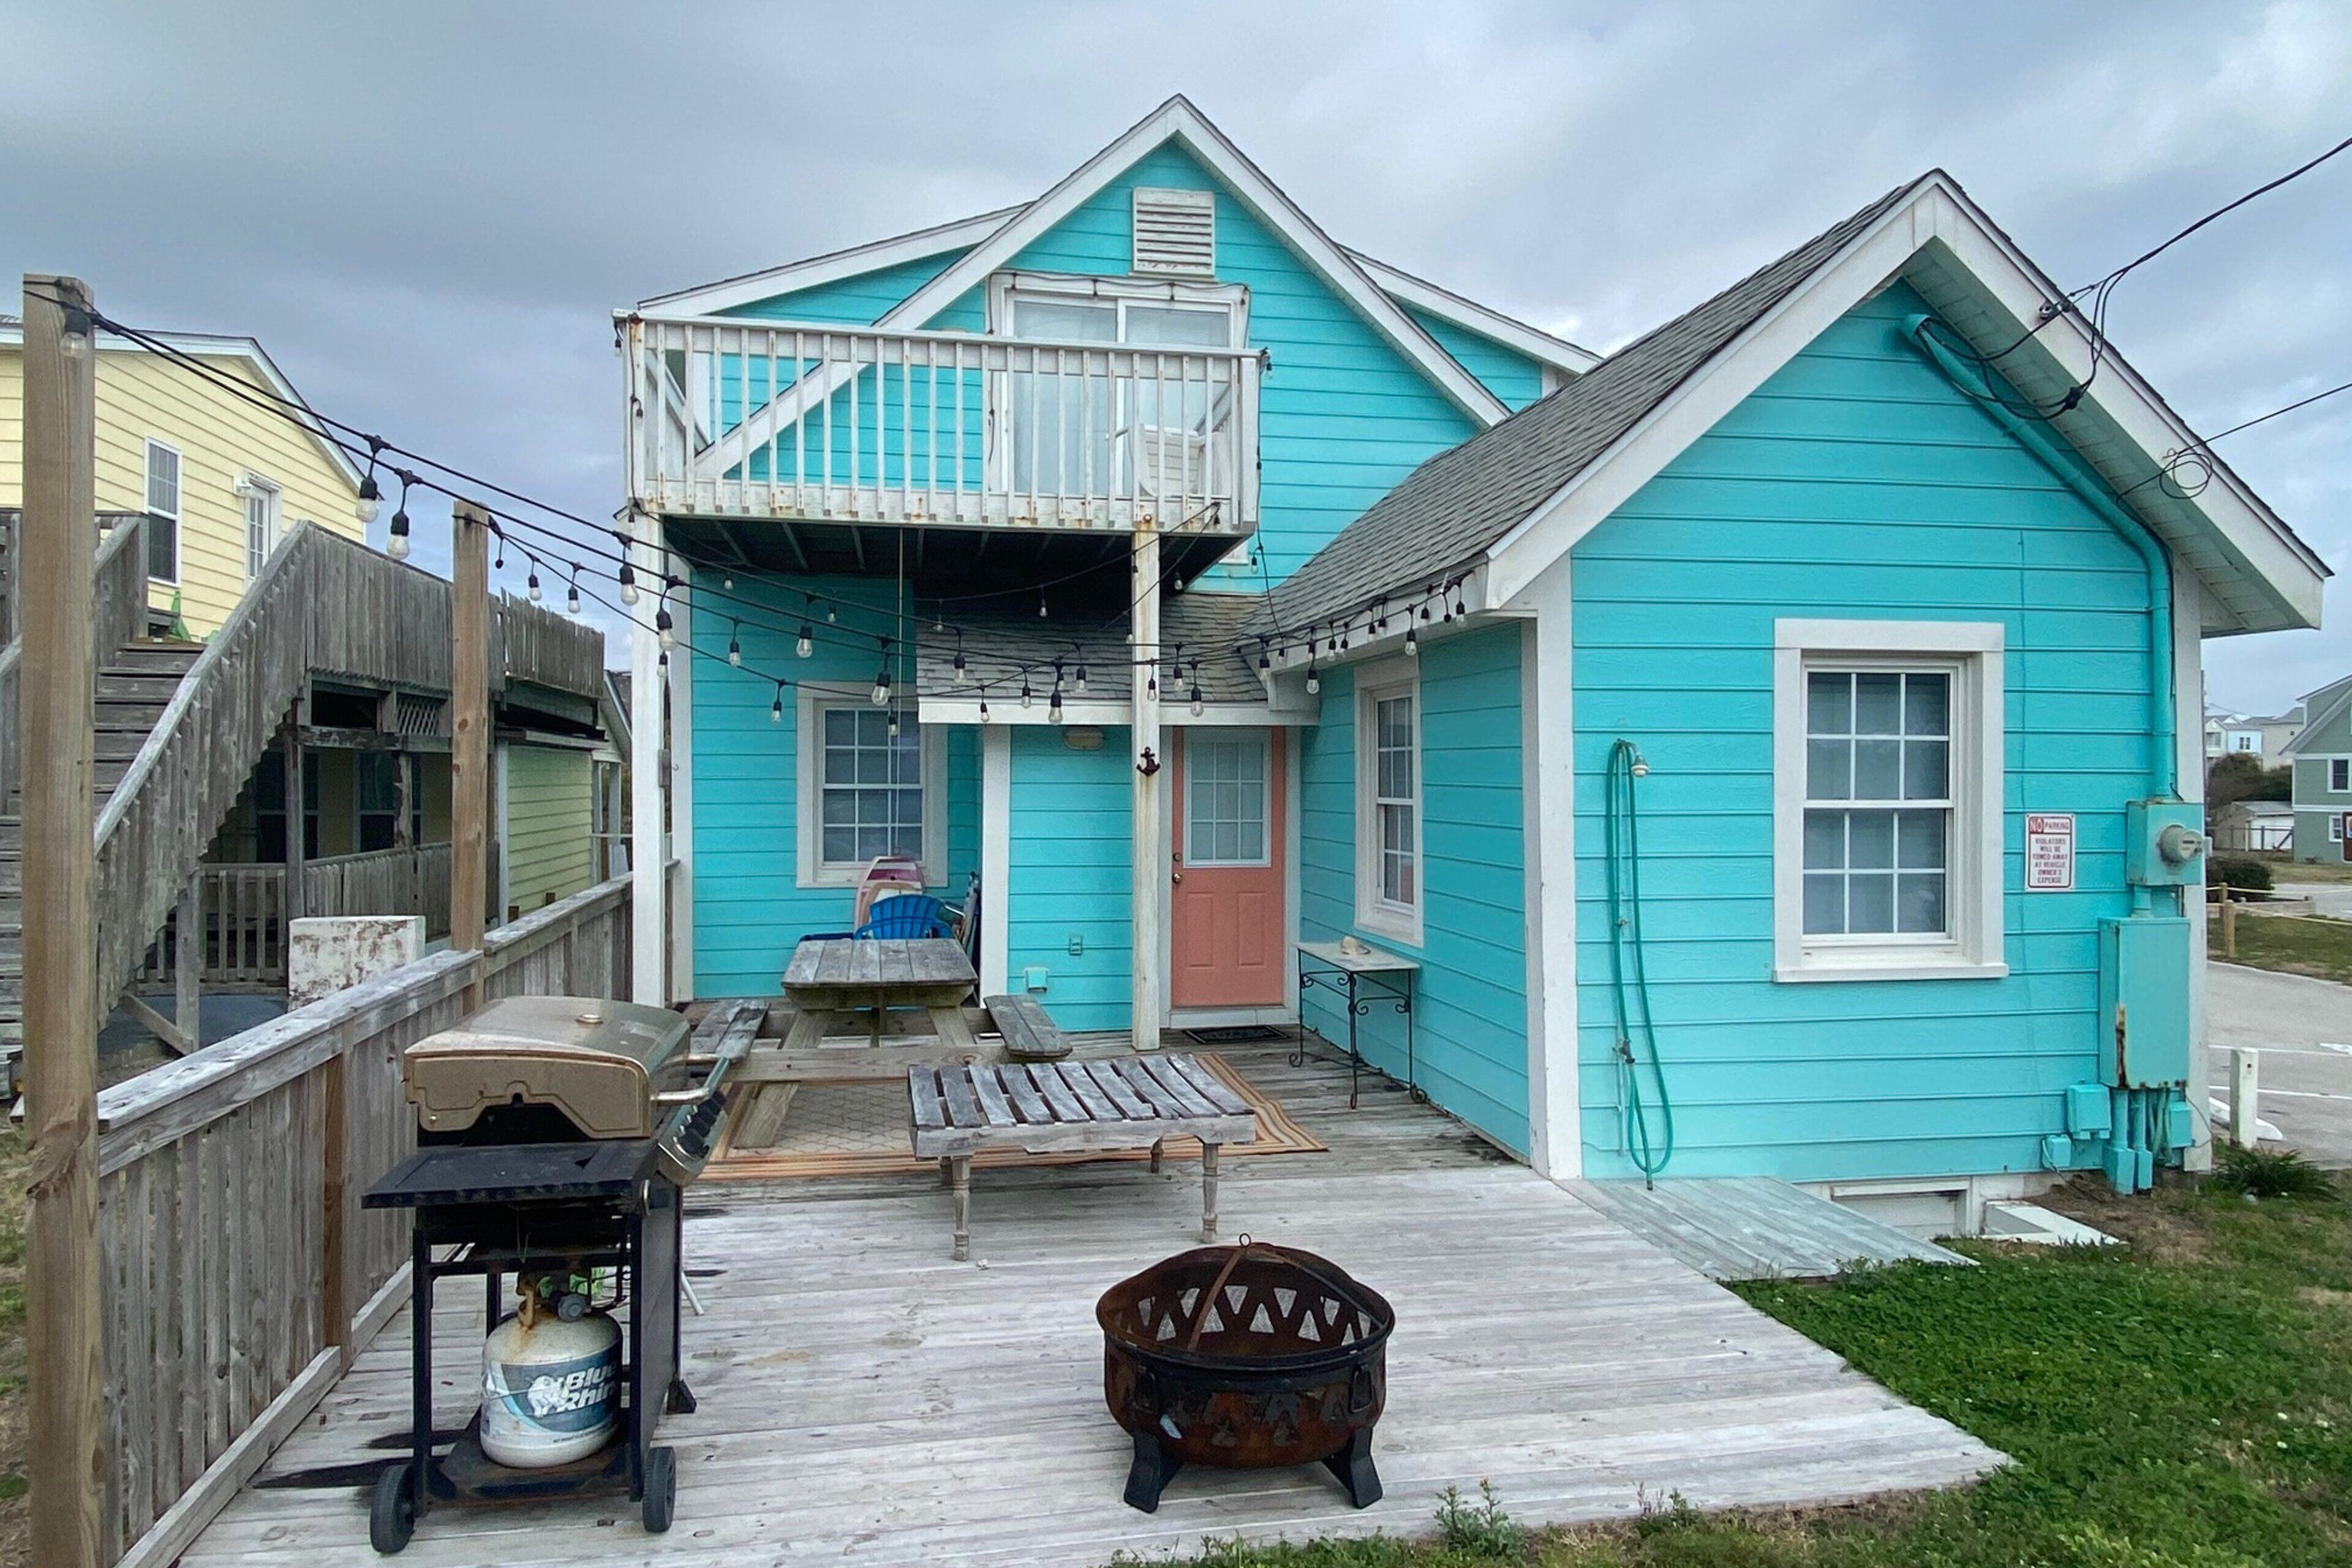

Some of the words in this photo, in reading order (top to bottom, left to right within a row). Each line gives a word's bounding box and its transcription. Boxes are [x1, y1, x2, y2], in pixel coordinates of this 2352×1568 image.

[2030, 817, 2042, 832] NO
[2045, 821, 2069, 830] PARKING
[556, 1381, 615, 1412] Rhin
